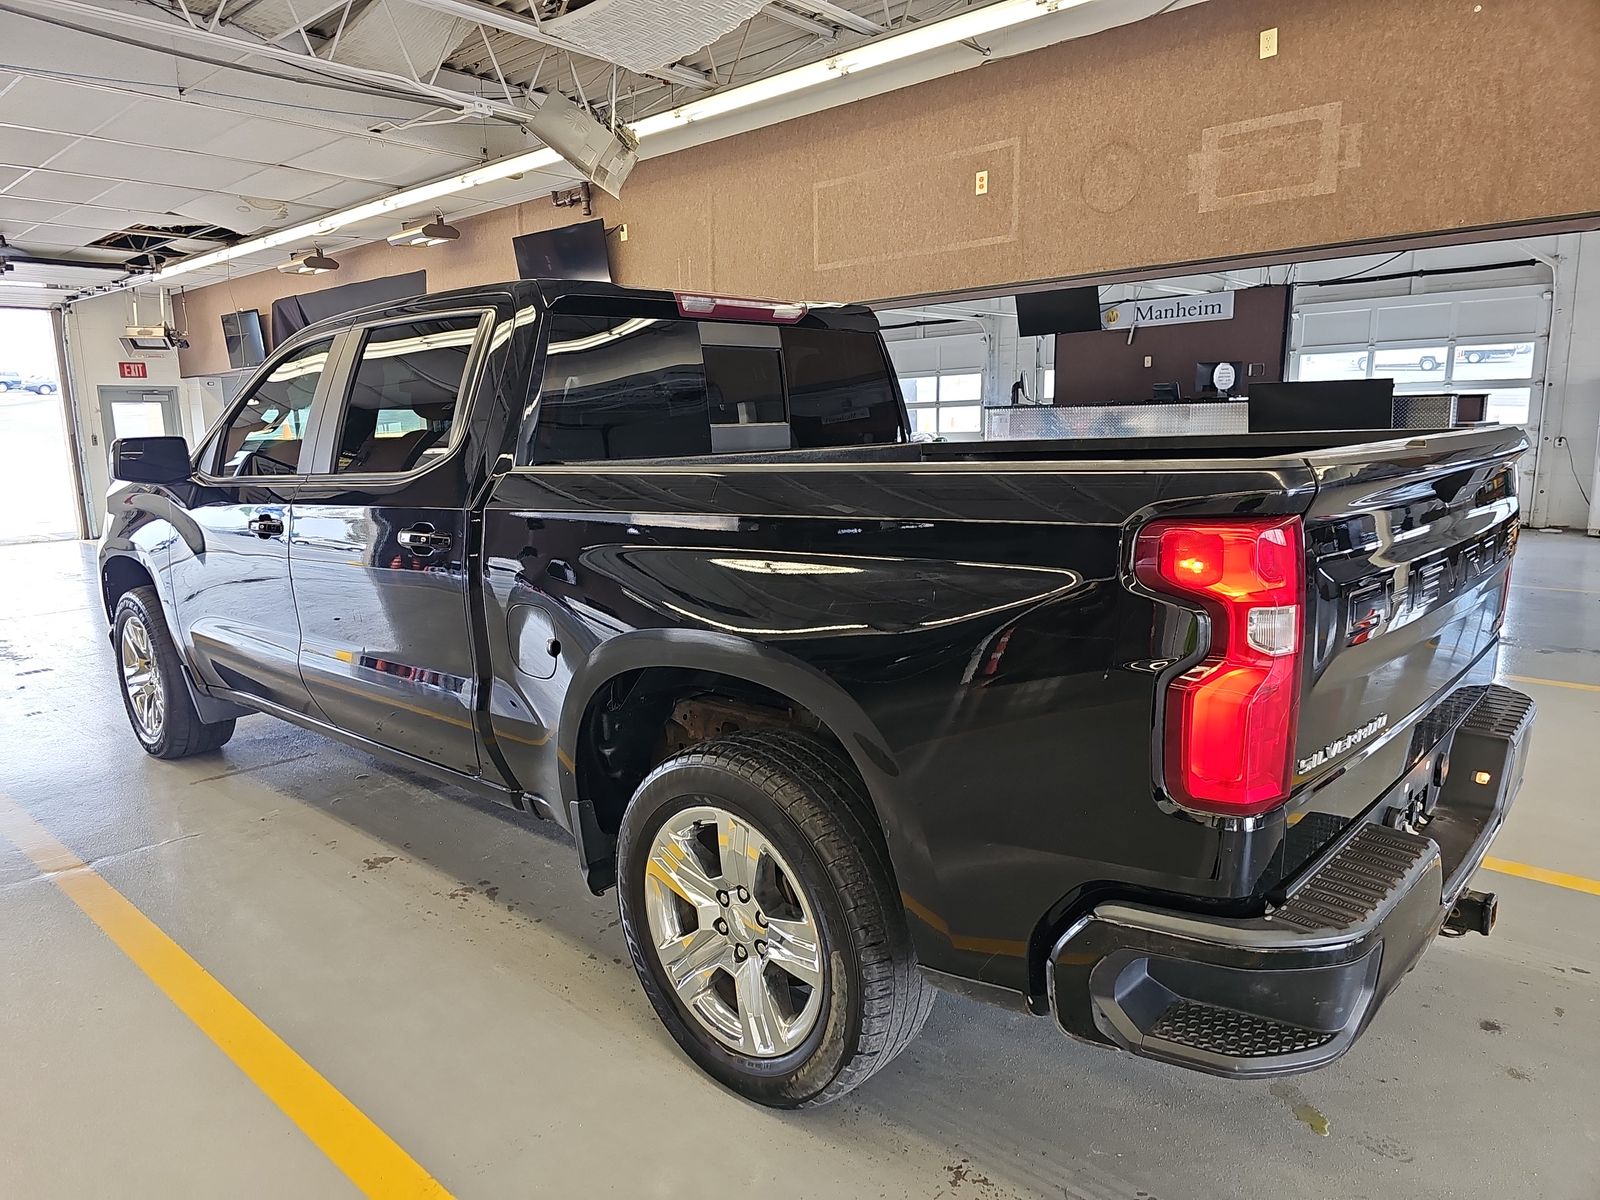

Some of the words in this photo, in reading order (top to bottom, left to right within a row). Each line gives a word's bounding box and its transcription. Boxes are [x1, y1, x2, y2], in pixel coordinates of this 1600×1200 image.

[1135, 299, 1223, 322] Manheim
[123, 363, 144, 377] EXIT
[1297, 712, 1388, 775] SILVERADO
